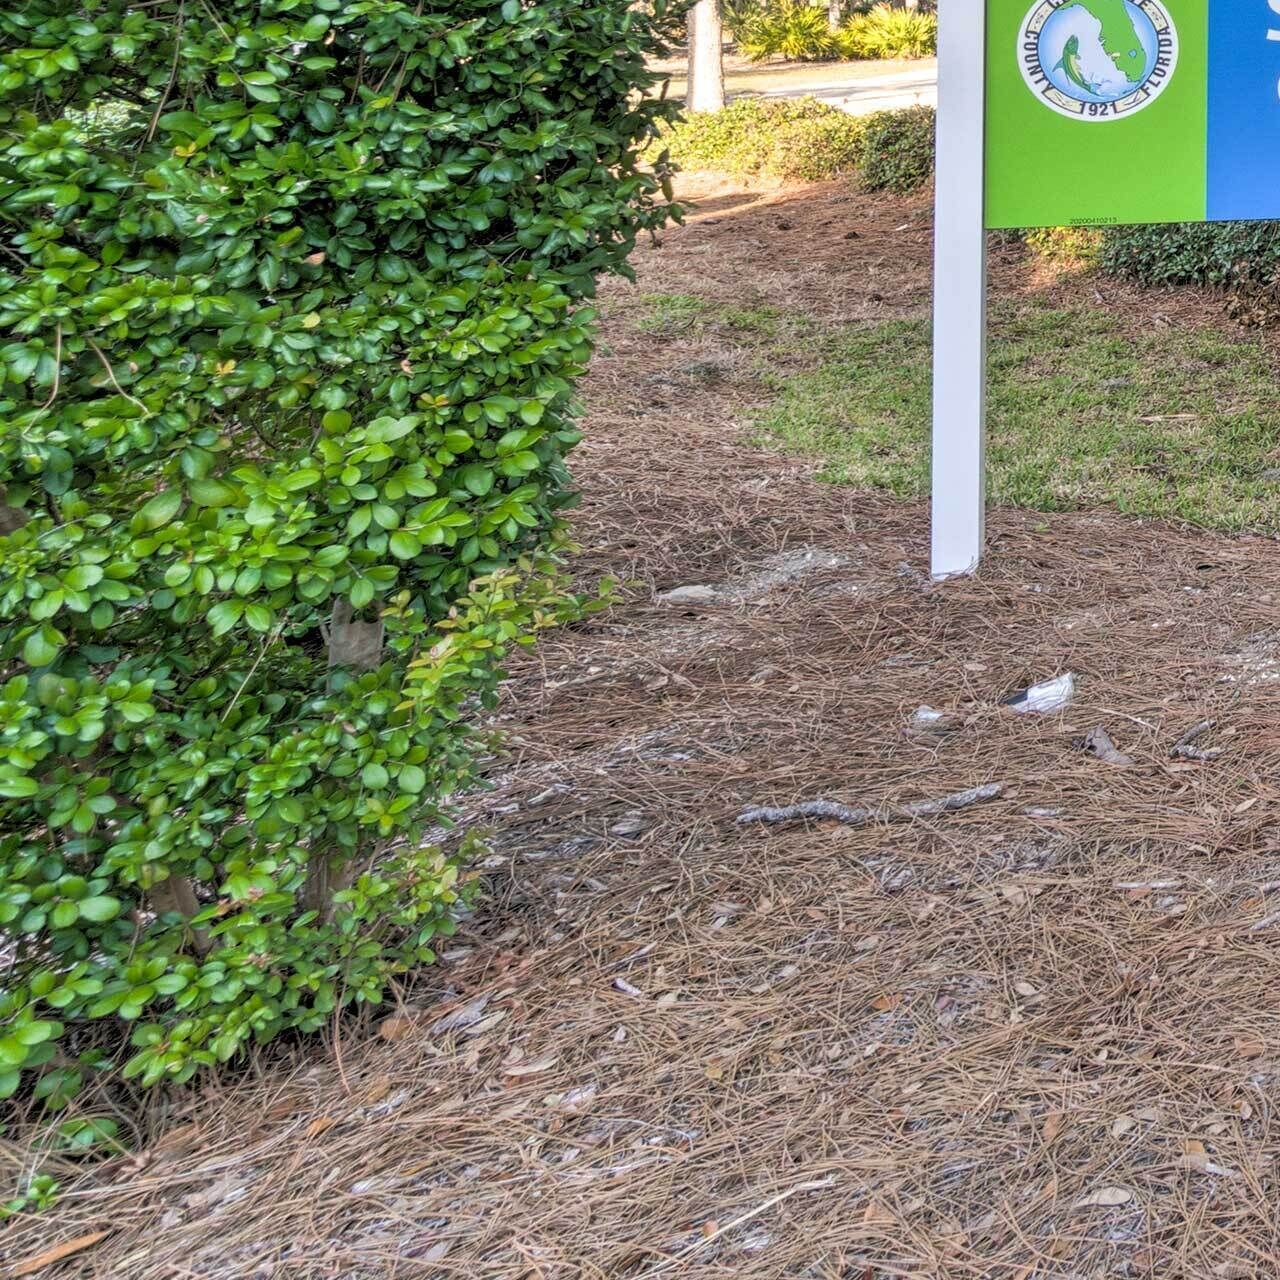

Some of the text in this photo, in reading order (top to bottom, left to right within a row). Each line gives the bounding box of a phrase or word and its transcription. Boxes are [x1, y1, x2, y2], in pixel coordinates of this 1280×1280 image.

[1023, 30, 1055, 94] COUNTY
[1140, 26, 1173, 96] FLORIDA
[1080, 102, 1117, 116] 1921
